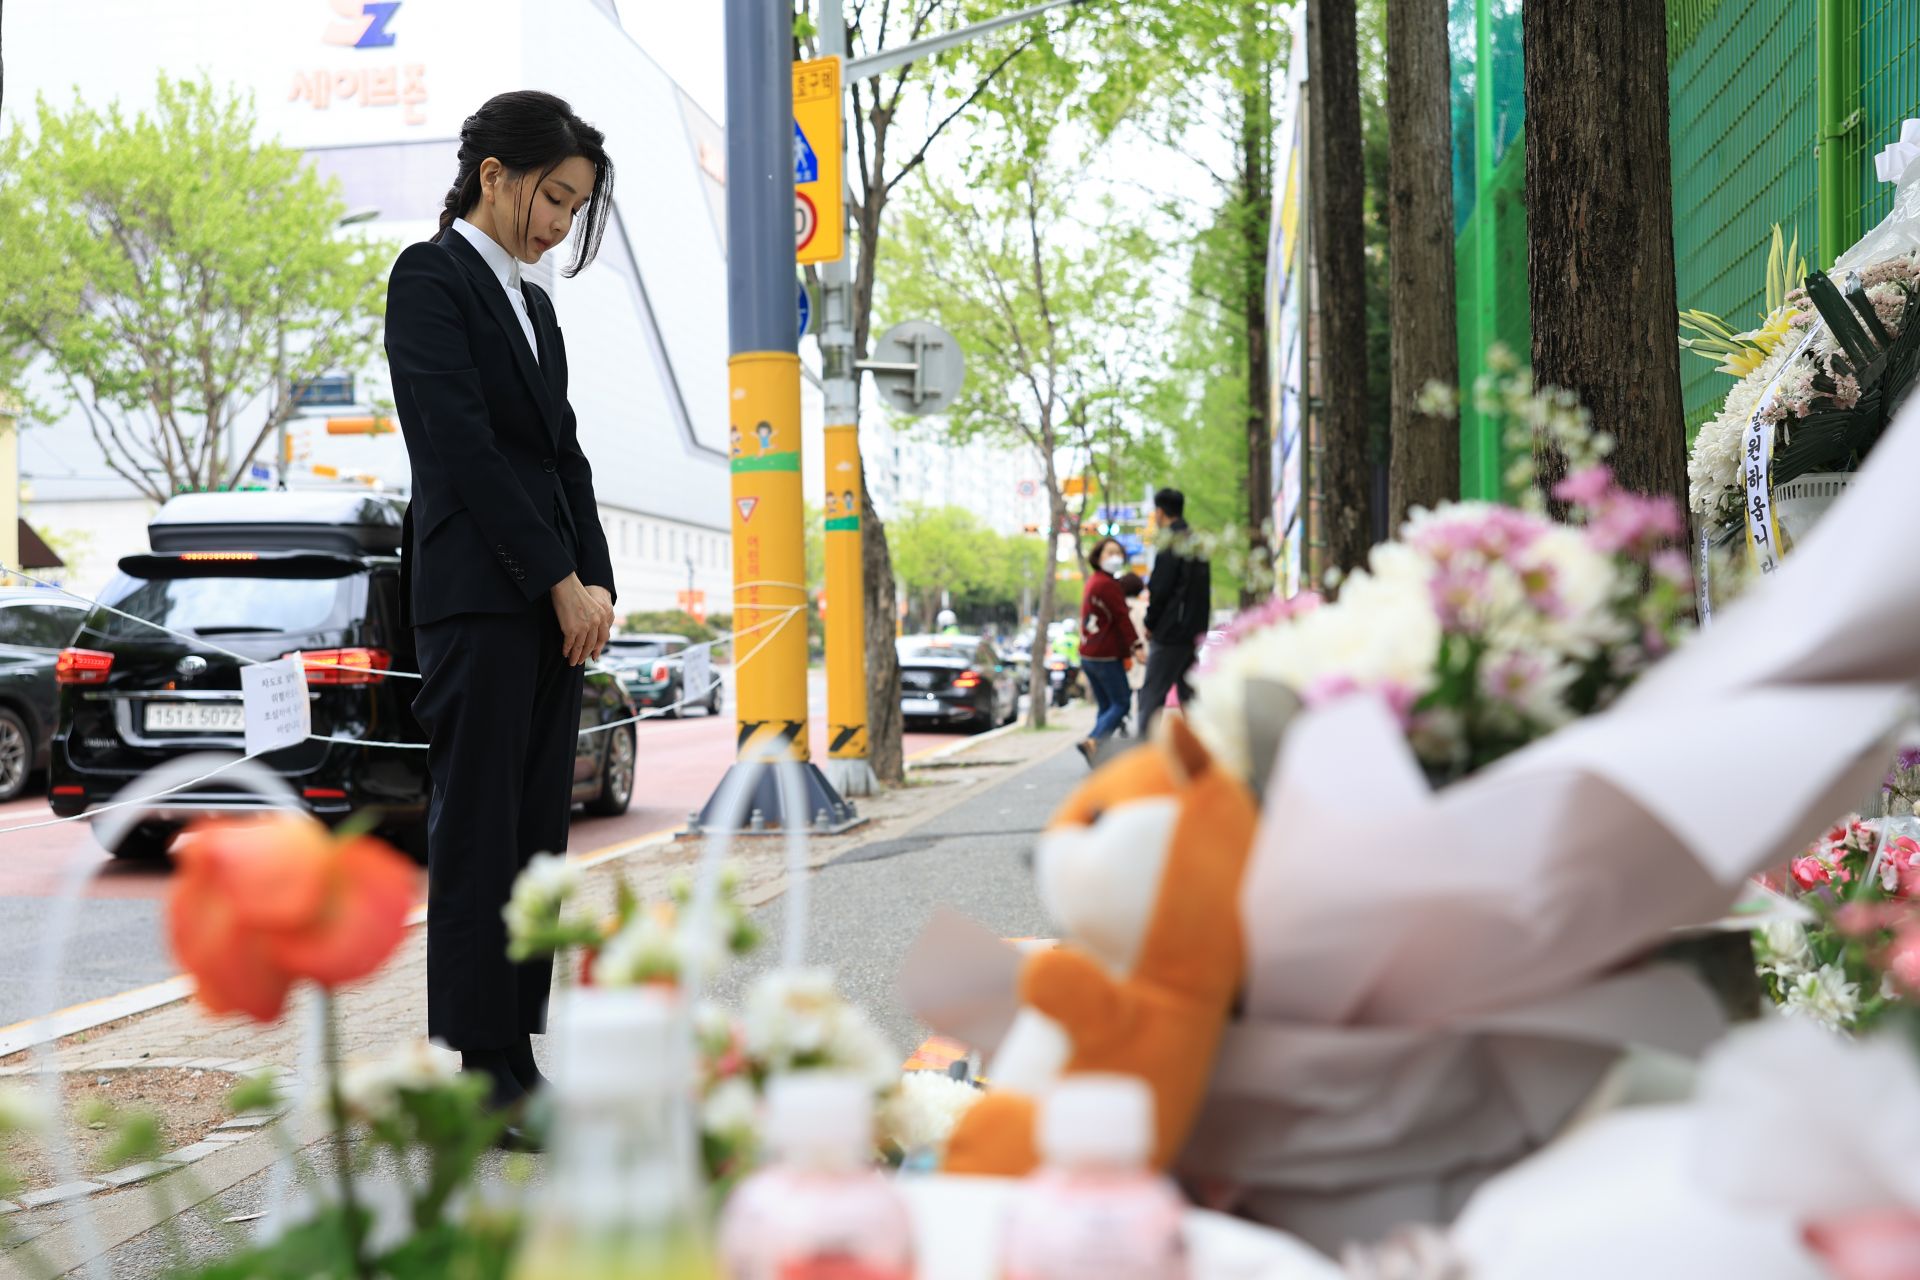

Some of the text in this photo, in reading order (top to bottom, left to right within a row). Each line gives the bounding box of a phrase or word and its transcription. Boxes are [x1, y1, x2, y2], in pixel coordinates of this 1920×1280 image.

[287, 64, 427, 126] 세이브존
[798, 72, 830, 97] 호구역
[795, 208, 807, 234] 0
